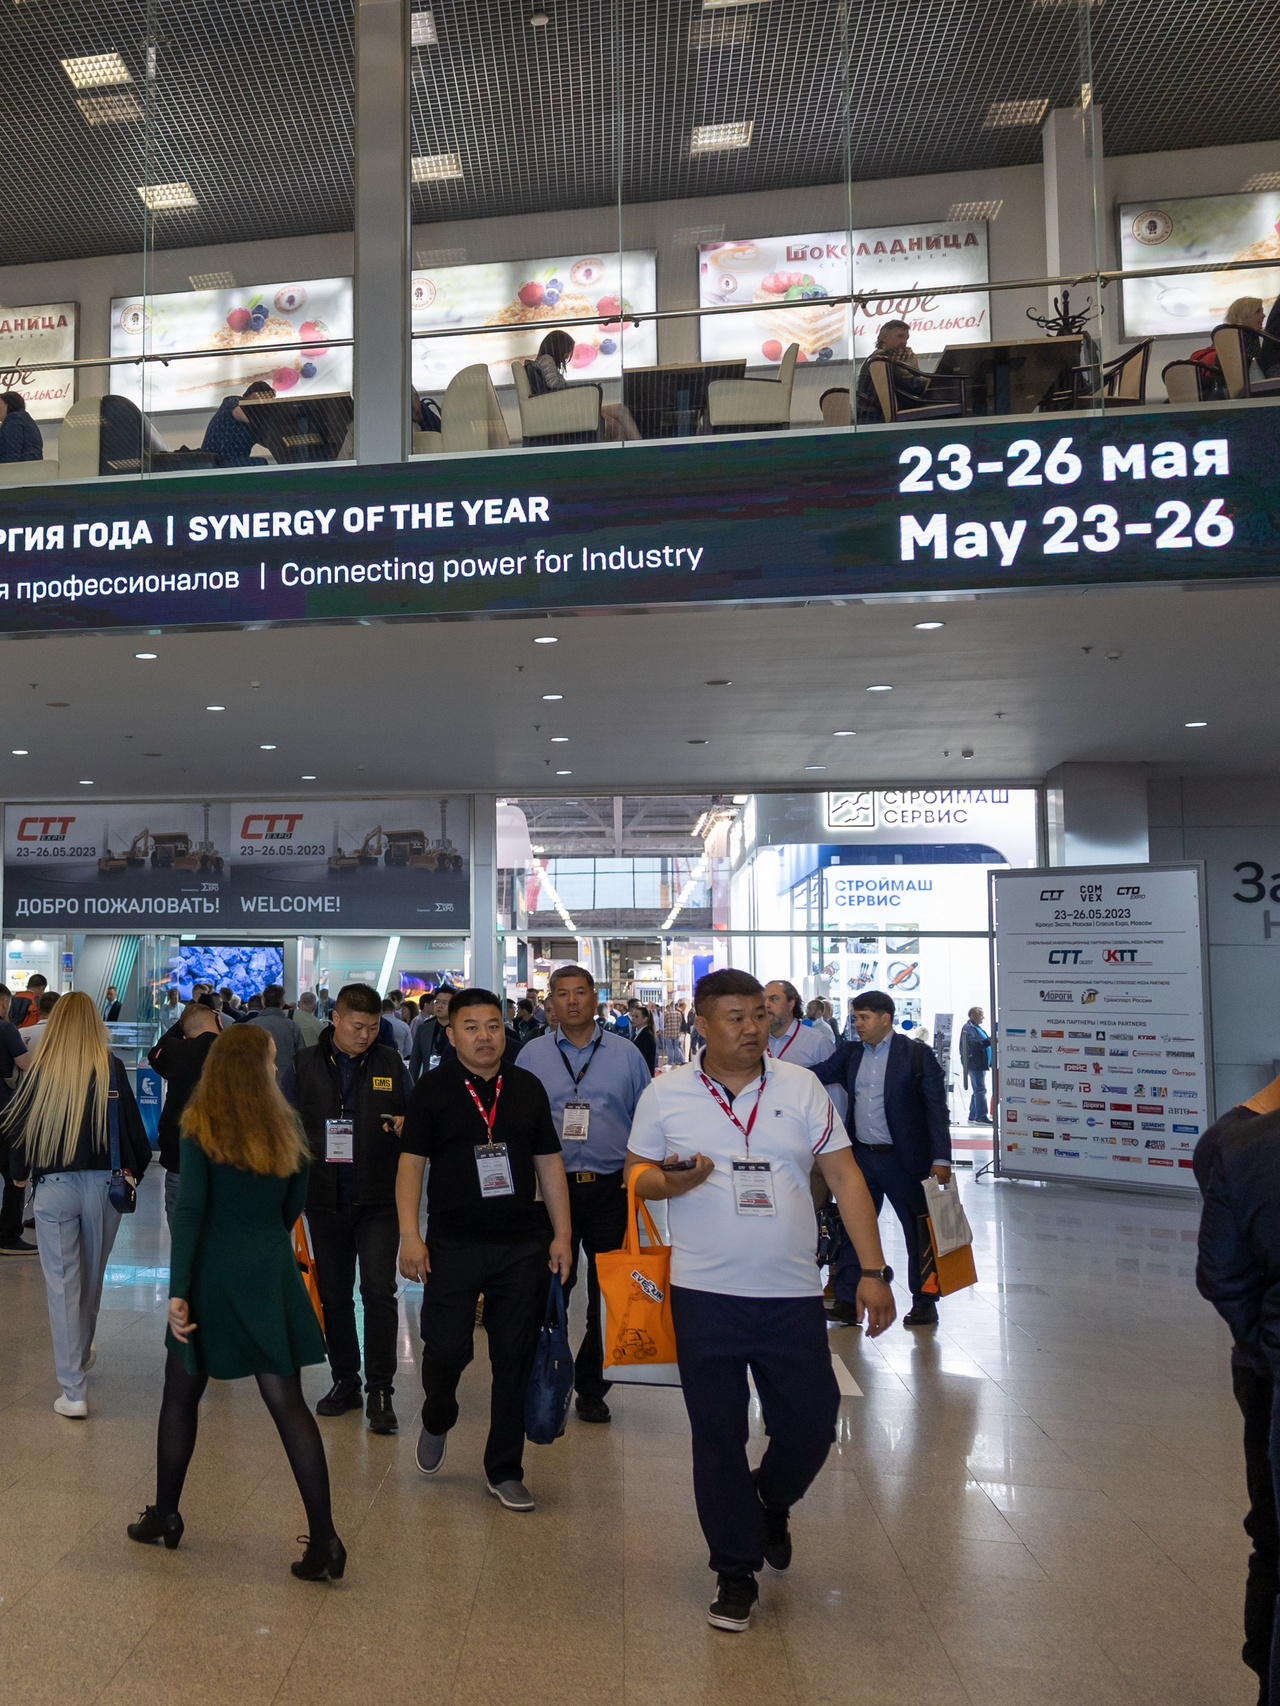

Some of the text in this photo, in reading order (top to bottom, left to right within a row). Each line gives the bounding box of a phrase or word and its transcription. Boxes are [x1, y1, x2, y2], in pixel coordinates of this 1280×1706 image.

[786, 232, 980, 262] ШОКОЛАДНИЦА
[898, 437, 1231, 493] 23-26 мая
[188, 496, 550, 542] SYNERGY OF THE YEAR
[73, 519, 153, 552] ГОДА
[900, 498, 1235, 566] May 23-26
[280, 545, 704, 586] Connecting power for Industry
[17, 571, 240, 602] профессионалов
[17, 816, 76, 841] CTT
[240, 814, 304, 840] CTT
[884, 809, 968, 824] СЕРВИС
[835, 877, 933, 891] СТРОЙМАШ
[1080, 885, 1102, 893] COM
[16, 896, 220, 917] ДОБРО ПОЖАЛОВАТЬ!
[240, 895, 341, 913] WELCOME!
[835, 894, 901, 906] СЕРВИС
[1080, 894, 1102, 902] VEX
[374, 1078, 391, 1087] GMS
